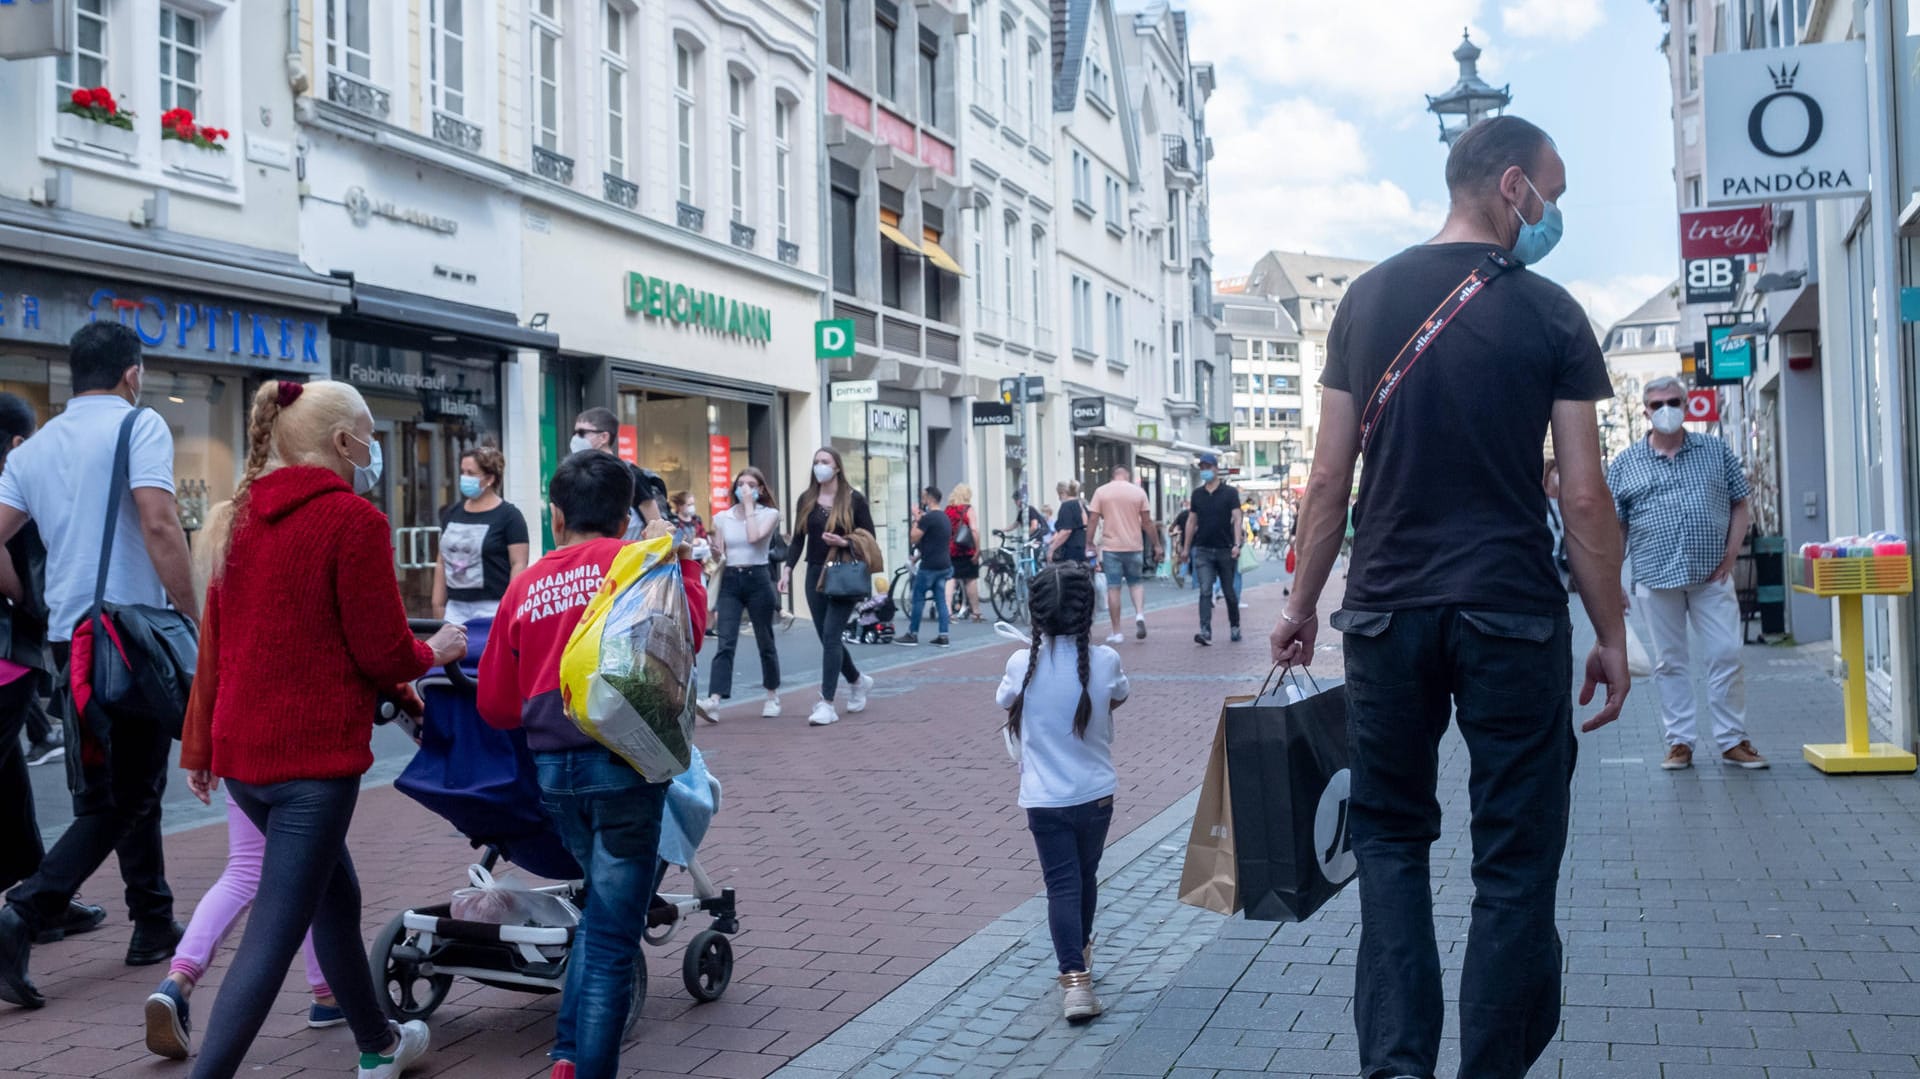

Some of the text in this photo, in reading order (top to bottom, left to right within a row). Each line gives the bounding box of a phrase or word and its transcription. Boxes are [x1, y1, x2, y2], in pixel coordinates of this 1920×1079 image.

[1723, 168, 1852, 196] PANDORA
[1688, 216, 1756, 248] tredy
[625, 270, 772, 343] DEICHMANN
[133, 297, 319, 364] OPTIKER
[822, 326, 846, 351] D
[1414, 318, 1443, 352] ellesse
[350, 363, 447, 390] Fabrikverkauf
[1378, 369, 1401, 404] ellesse
[441, 397, 478, 416] Italien
[974, 415, 1010, 424] MANGO
[1073, 407, 1102, 418] ONLY
[527, 563, 601, 597] ΑΚΑΔΗΜΙΑ
[516, 577, 605, 619] ΠΟΔΟΣΦΑΙΡΟ
